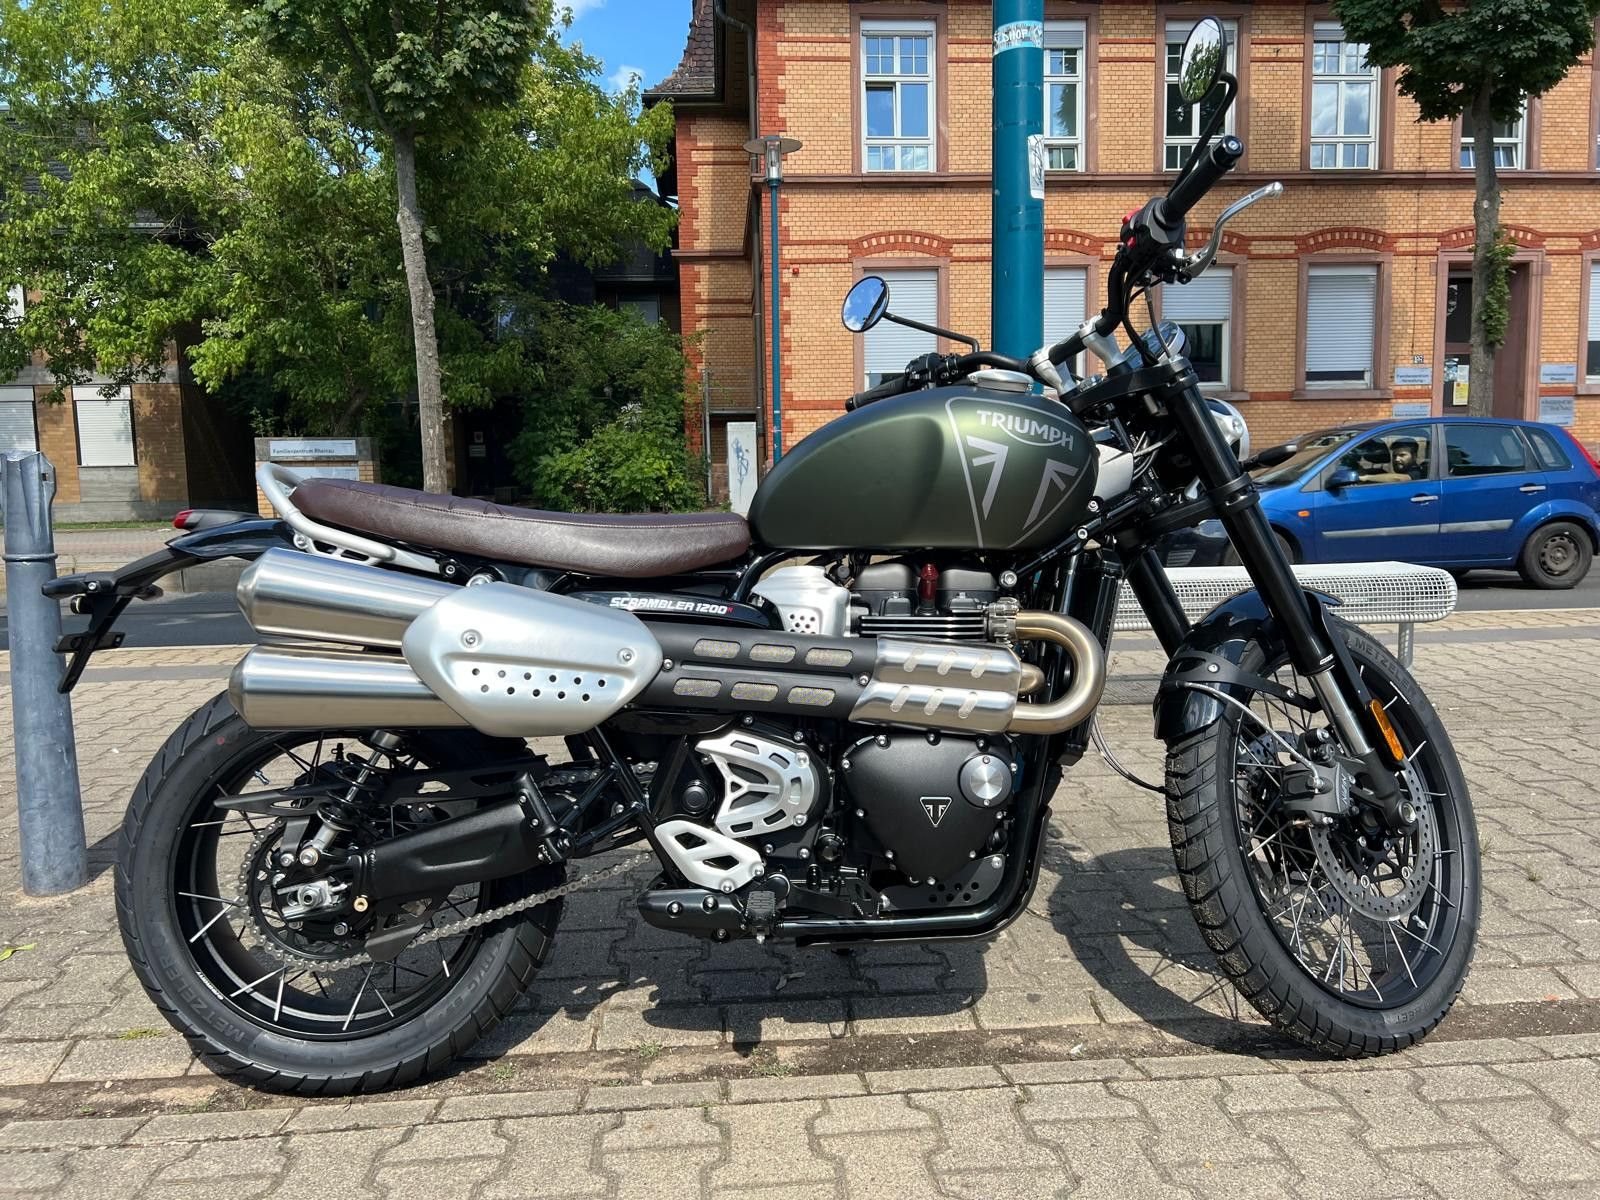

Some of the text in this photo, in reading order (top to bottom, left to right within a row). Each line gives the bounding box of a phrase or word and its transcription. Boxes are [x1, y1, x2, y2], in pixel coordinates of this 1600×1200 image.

[977, 410, 1074, 451] TRIUMPH
[609, 597, 694, 611] SCRAMBLER
[696, 602, 728, 615] 1200
[159, 955, 246, 1042] METZELER
